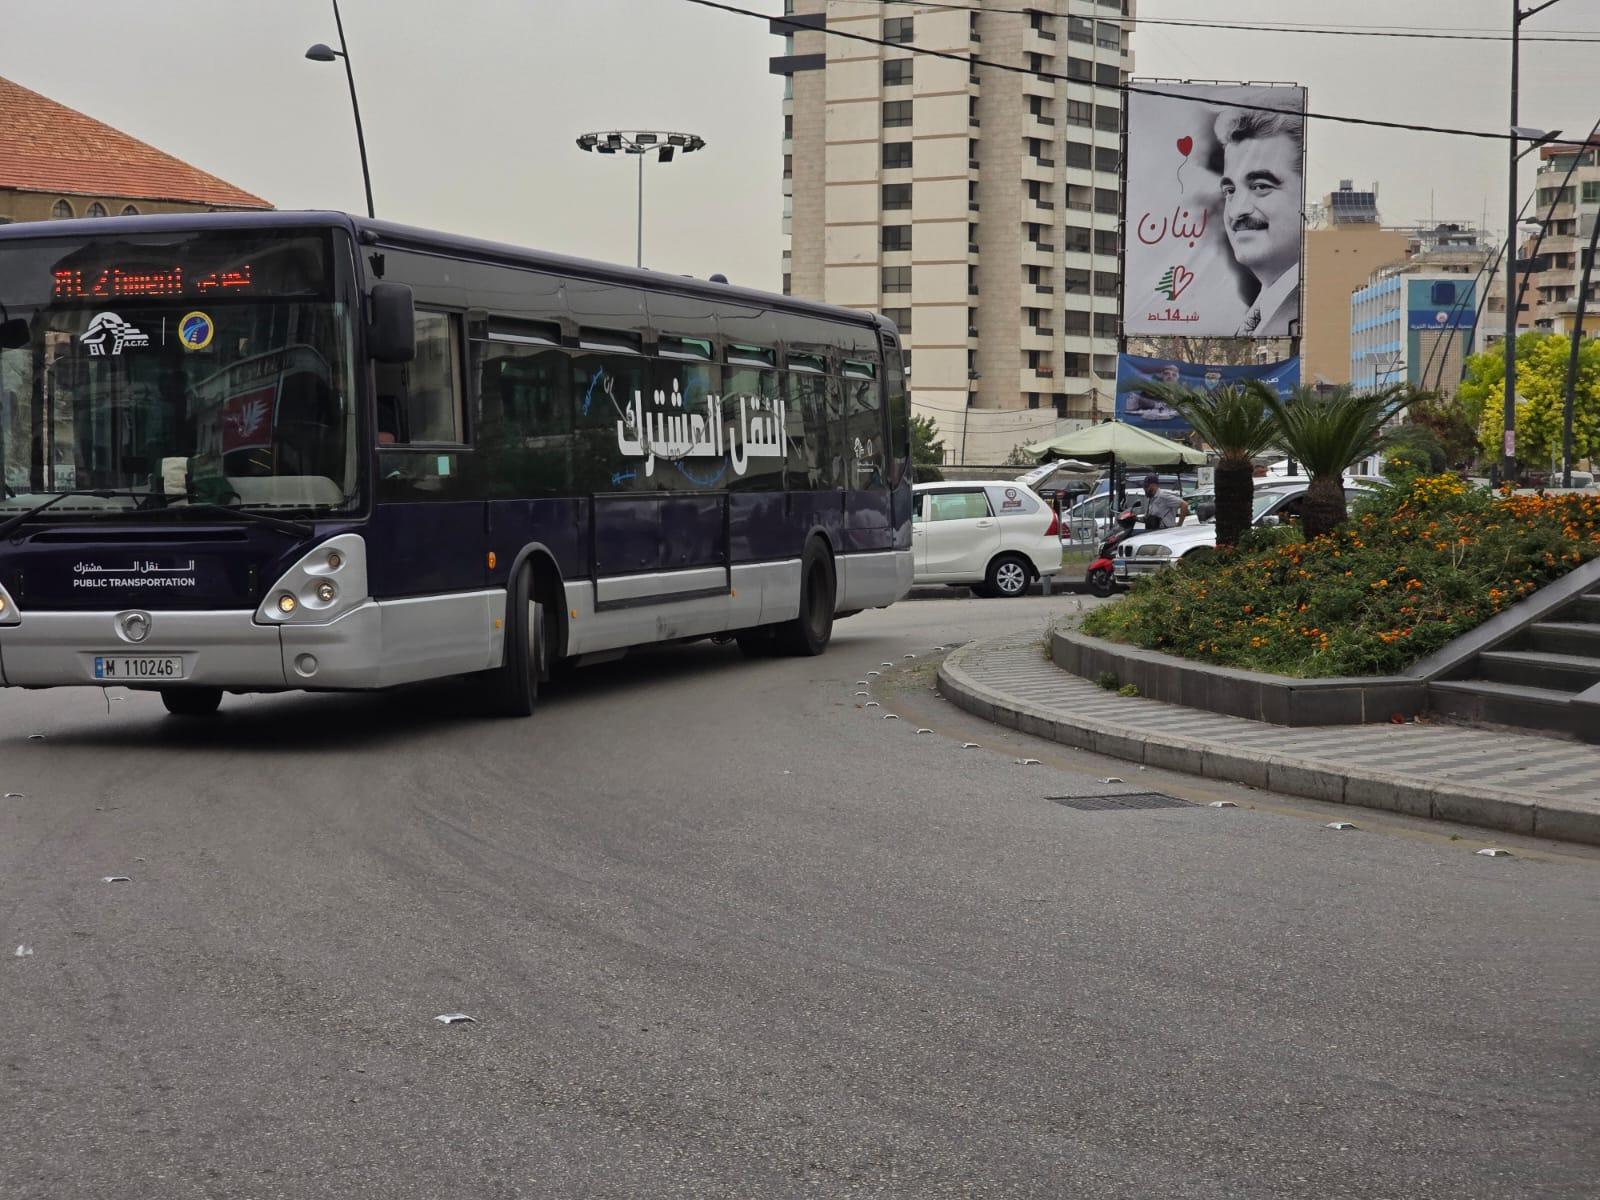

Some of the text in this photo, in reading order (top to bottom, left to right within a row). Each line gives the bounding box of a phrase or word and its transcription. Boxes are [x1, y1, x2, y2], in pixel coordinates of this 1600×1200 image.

[1138, 206, 1208, 248] لبنان
[617, 377, 723, 477] المشترك
[729, 396, 788, 476] النقل
[73, 560, 195, 575] النقل المشترك
[73, 578, 195, 587] PUBLIC TRANSPORTATION
[106, 660, 173, 676] M 110246
